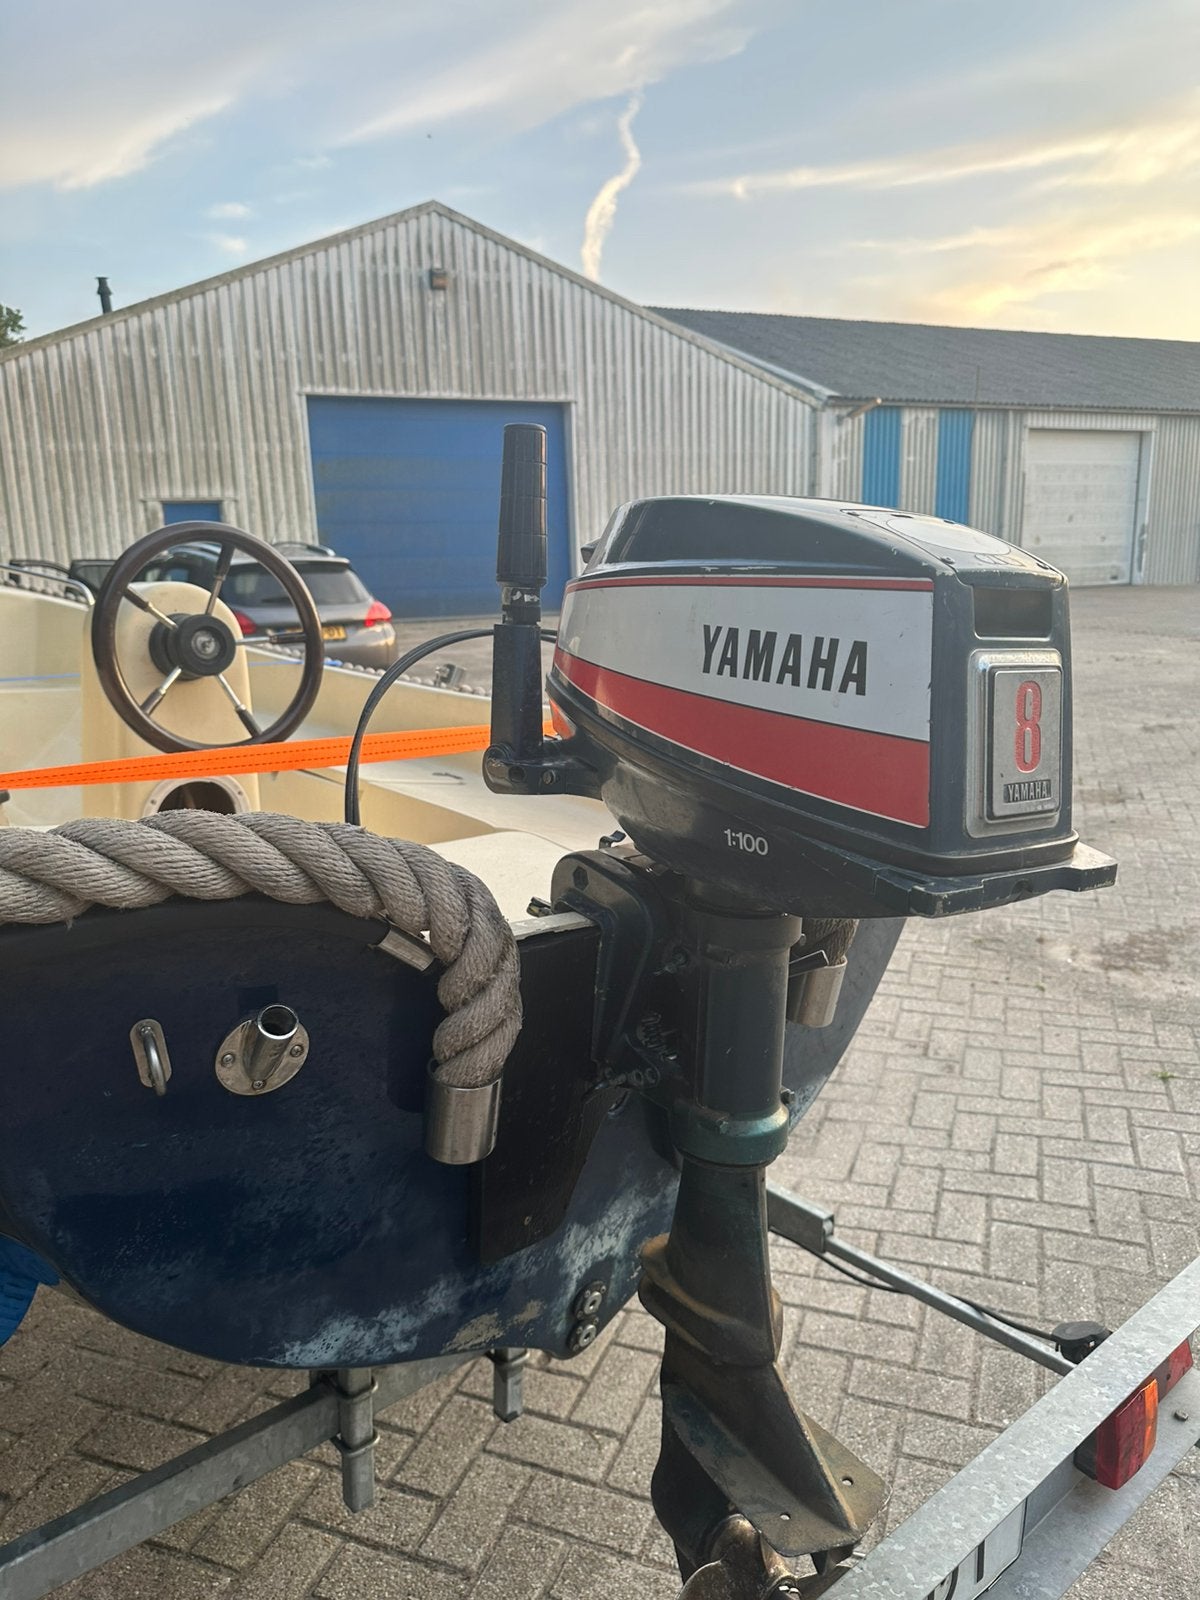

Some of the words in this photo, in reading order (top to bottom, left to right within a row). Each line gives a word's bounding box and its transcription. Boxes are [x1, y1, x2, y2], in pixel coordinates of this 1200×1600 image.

[703, 624, 868, 697] YAMAHA
[1015, 680, 1042, 774] 8
[1007, 780, 1050, 803] YAMAHA
[723, 828, 769, 856] 1:100
